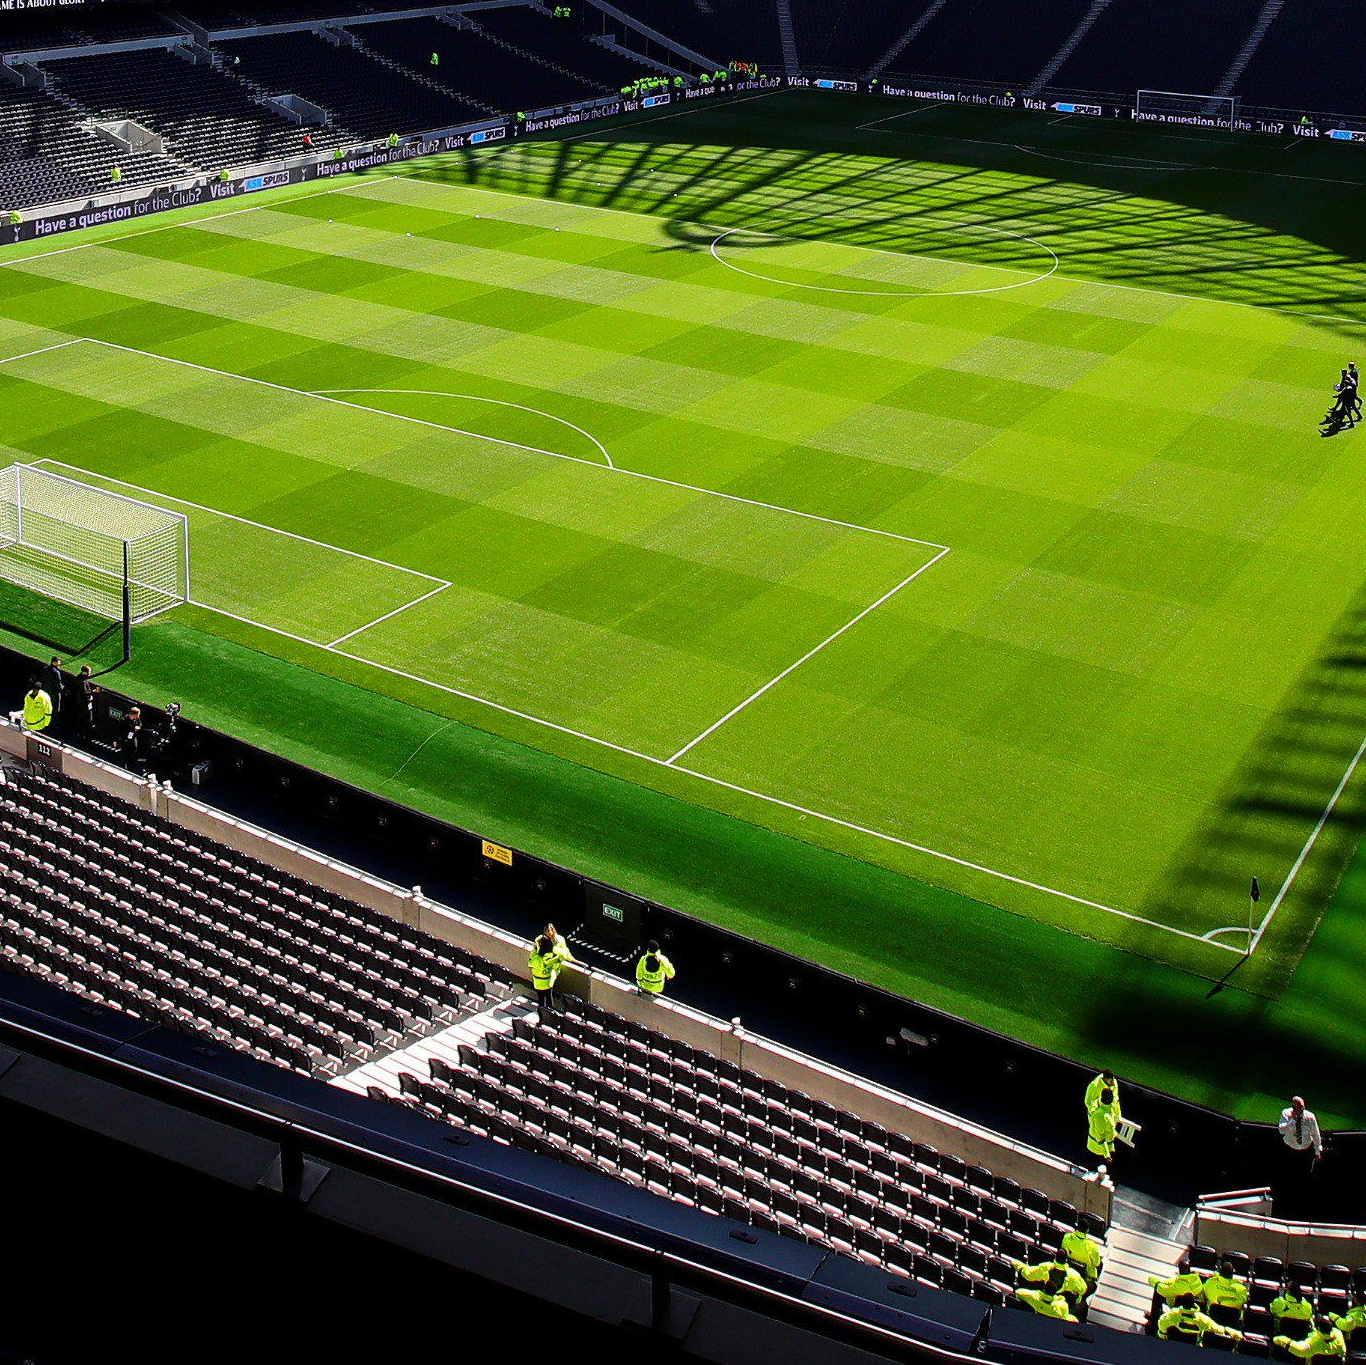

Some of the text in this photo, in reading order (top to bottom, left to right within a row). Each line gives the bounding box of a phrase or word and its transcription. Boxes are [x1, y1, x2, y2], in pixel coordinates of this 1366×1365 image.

[526, 100, 638, 132] Have a question for the Club? Visit
[317, 135, 463, 176] Have a question for the Club? Visit
[35, 183, 235, 235] Have a question for the Club? Visit
[39, 744, 51, 756] 112
[604, 906, 621, 920] EXIT
